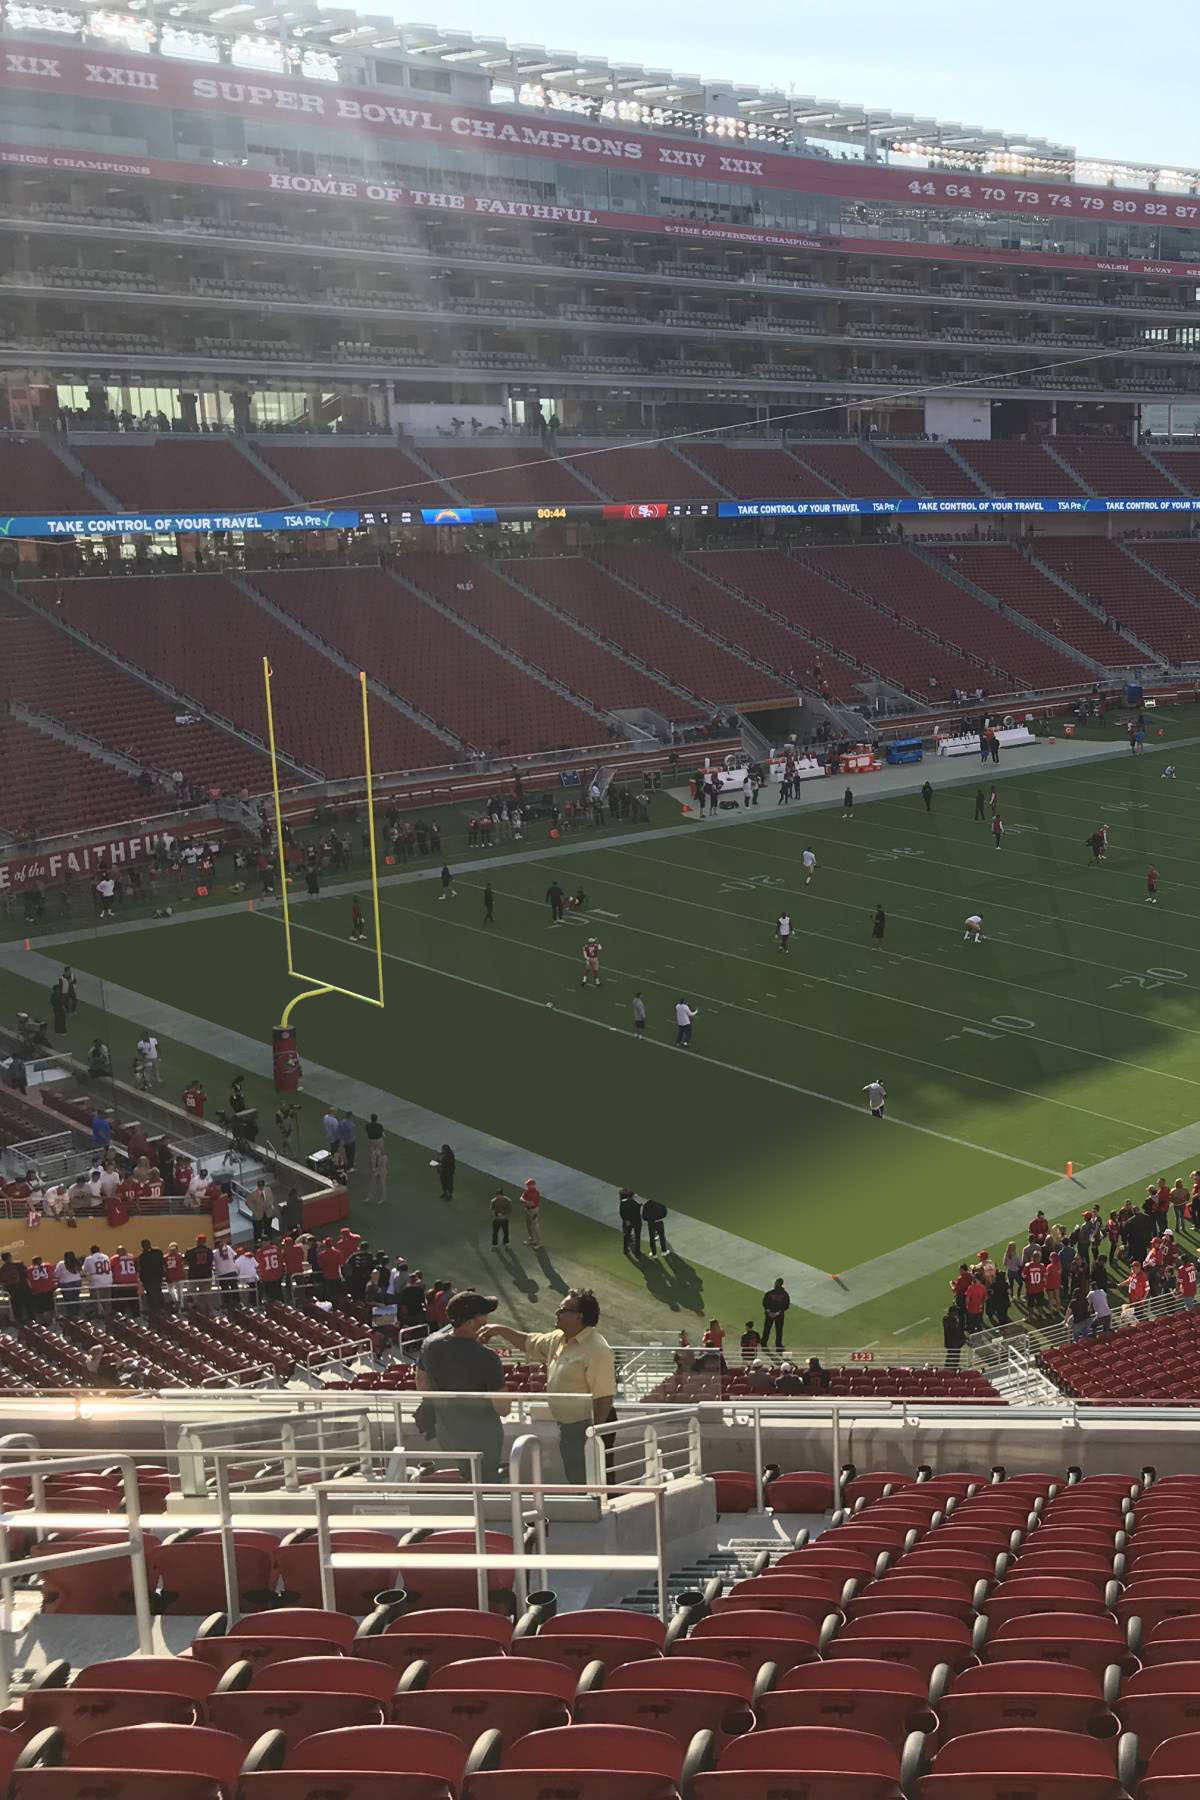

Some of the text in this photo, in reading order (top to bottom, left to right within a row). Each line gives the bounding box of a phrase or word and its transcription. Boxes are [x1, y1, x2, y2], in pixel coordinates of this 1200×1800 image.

[5, 54, 763, 175] XIX XXIII SUPER BOWL CHAMPIONS XXIV XXIX
[53, 158, 151, 175] CHAMPIONS
[269, 173, 598, 224] HOME OF THE FAITHFUL
[908, 180, 936, 195] 44
[945, 184, 972, 198] 64
[981, 187, 1006, 201] 70
[1014, 190, 1039, 204] 73
[1048, 193, 1072, 207] 74
[1080, 196, 1104, 210] 79
[1112, 199, 1136, 213] 80
[1144, 203, 1168, 216] 82
[1175, 206, 1198, 218] 87
[702, 229, 764, 242] CONFERENCE
[738, 503, 859, 514] TAKE CONTROL OF YOUR TRAVEL
[873, 503, 885, 512] TSA
[917, 501, 1044, 511] TAKE CONTROL OF YOUR TRAVEL
[1058, 501, 1070, 510] TSA
[1106, 501, 1124, 509] TAKE
[1126, 501, 1159, 509] CONTROL
[1160, 501, 1169, 509] OF
[1172, 501, 1191, 509] YOUR
[537, 508, 566, 519] 90:44
[47, 517, 262, 533] TAKE CONTROL OF YOUR TRAVEL
[284, 516, 321, 527] TSA Pre
[14, 864, 26, 883] of
[28, 862, 45, 878] the
[95, 1260, 110, 1275] 80
[120, 1260, 136, 1275] 16
[264, 1254, 279, 1270] 16
[1030, 1271, 1041, 1284] 10
[853, 1353, 873, 1362] 123
